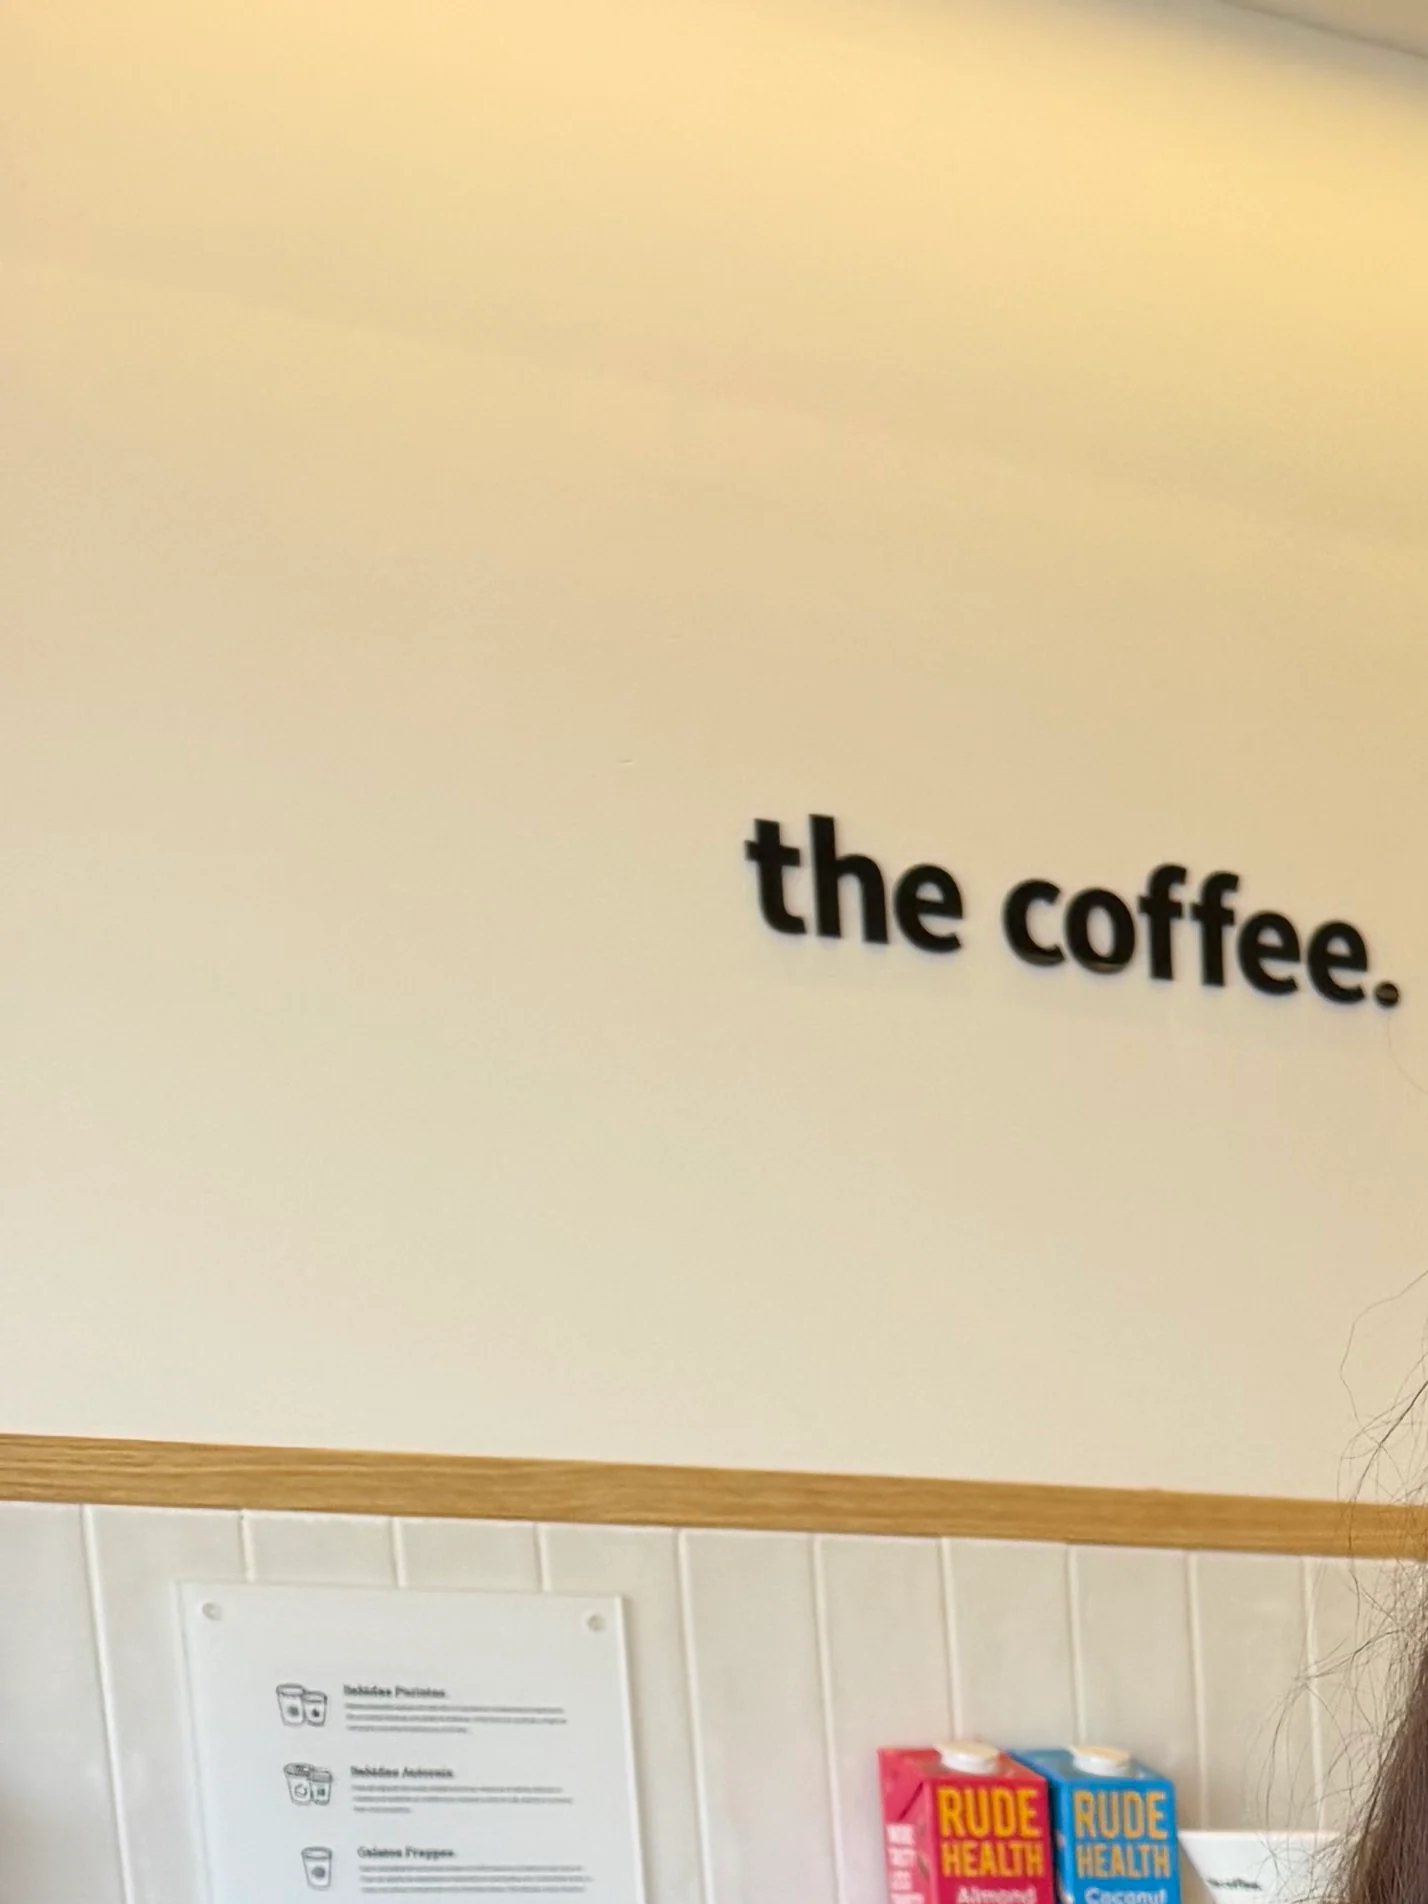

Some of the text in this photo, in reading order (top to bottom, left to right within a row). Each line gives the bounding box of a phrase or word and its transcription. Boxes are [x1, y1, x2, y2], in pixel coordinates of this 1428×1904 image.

[745, 814, 1401, 1008] the coffee.
[937, 1786, 1042, 1840] RUDE
[1073, 1789, 1169, 1840] RUDE
[940, 1840, 1044, 1878] HEALTH
[1076, 1844, 1172, 1879] HEALTH
